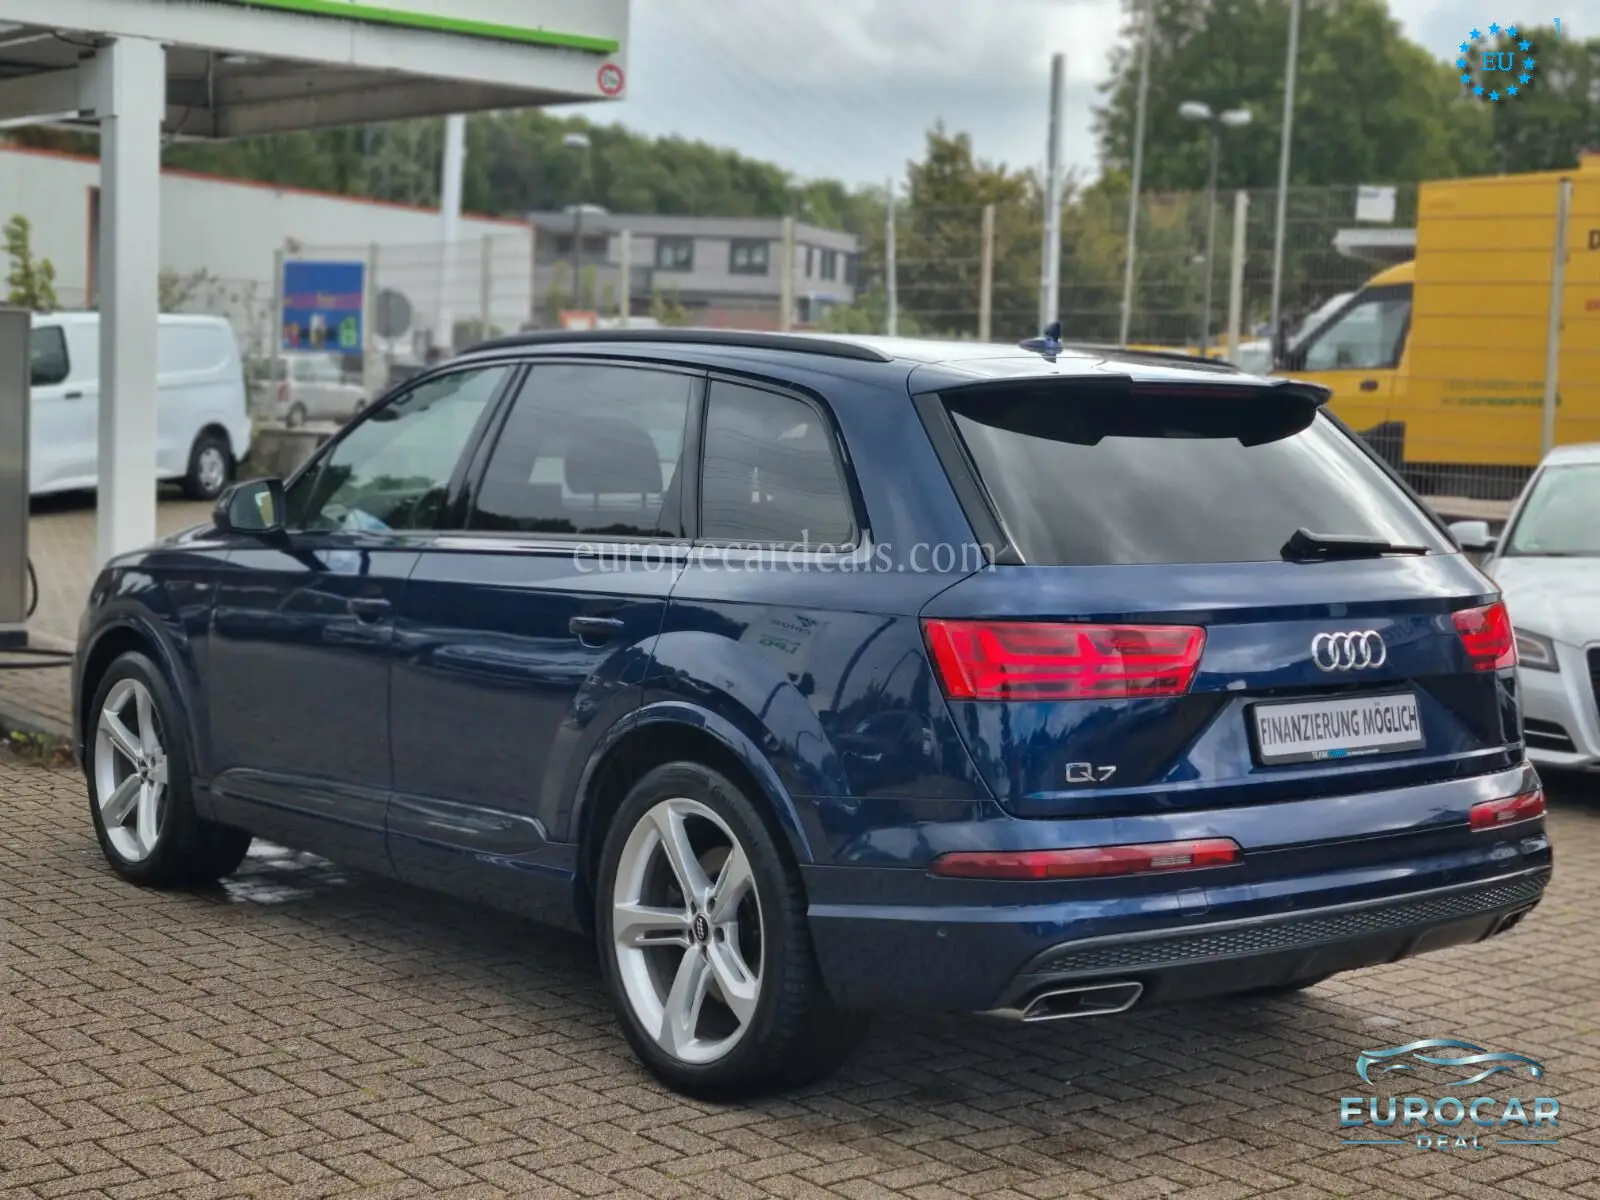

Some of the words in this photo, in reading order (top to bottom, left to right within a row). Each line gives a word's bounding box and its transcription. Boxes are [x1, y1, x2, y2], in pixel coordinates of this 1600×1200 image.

[1260, 709, 1360, 745] FINANZIERUNG
[1363, 700, 1419, 735] MÖGLICH
[1065, 762, 1117, 783] Q7
